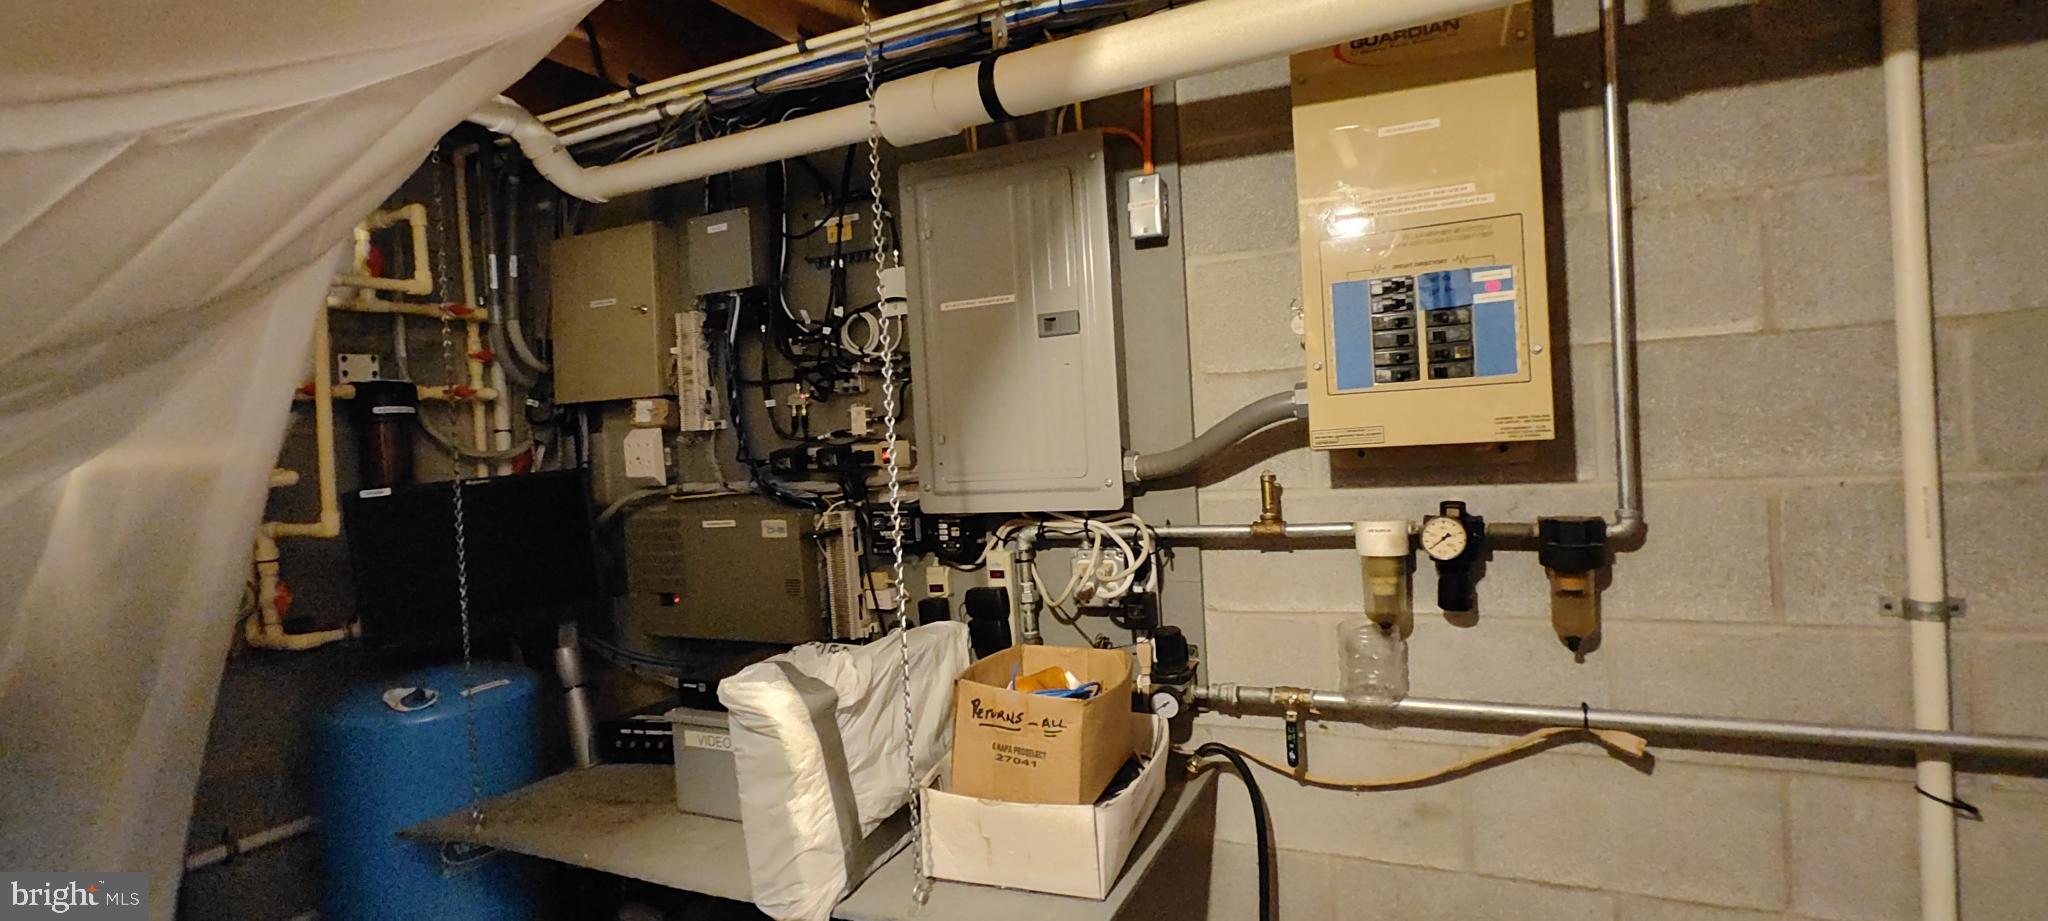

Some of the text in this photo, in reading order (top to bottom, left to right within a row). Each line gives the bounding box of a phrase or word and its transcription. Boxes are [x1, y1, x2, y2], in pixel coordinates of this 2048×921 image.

[1350, 18, 1460, 49] GUARDIAN
[1041, 717, 1067, 728] ALL
[697, 735, 732, 749] VIDEO
[997, 743, 1012, 754] NAPA
[995, 753, 1037, 768] 27041
